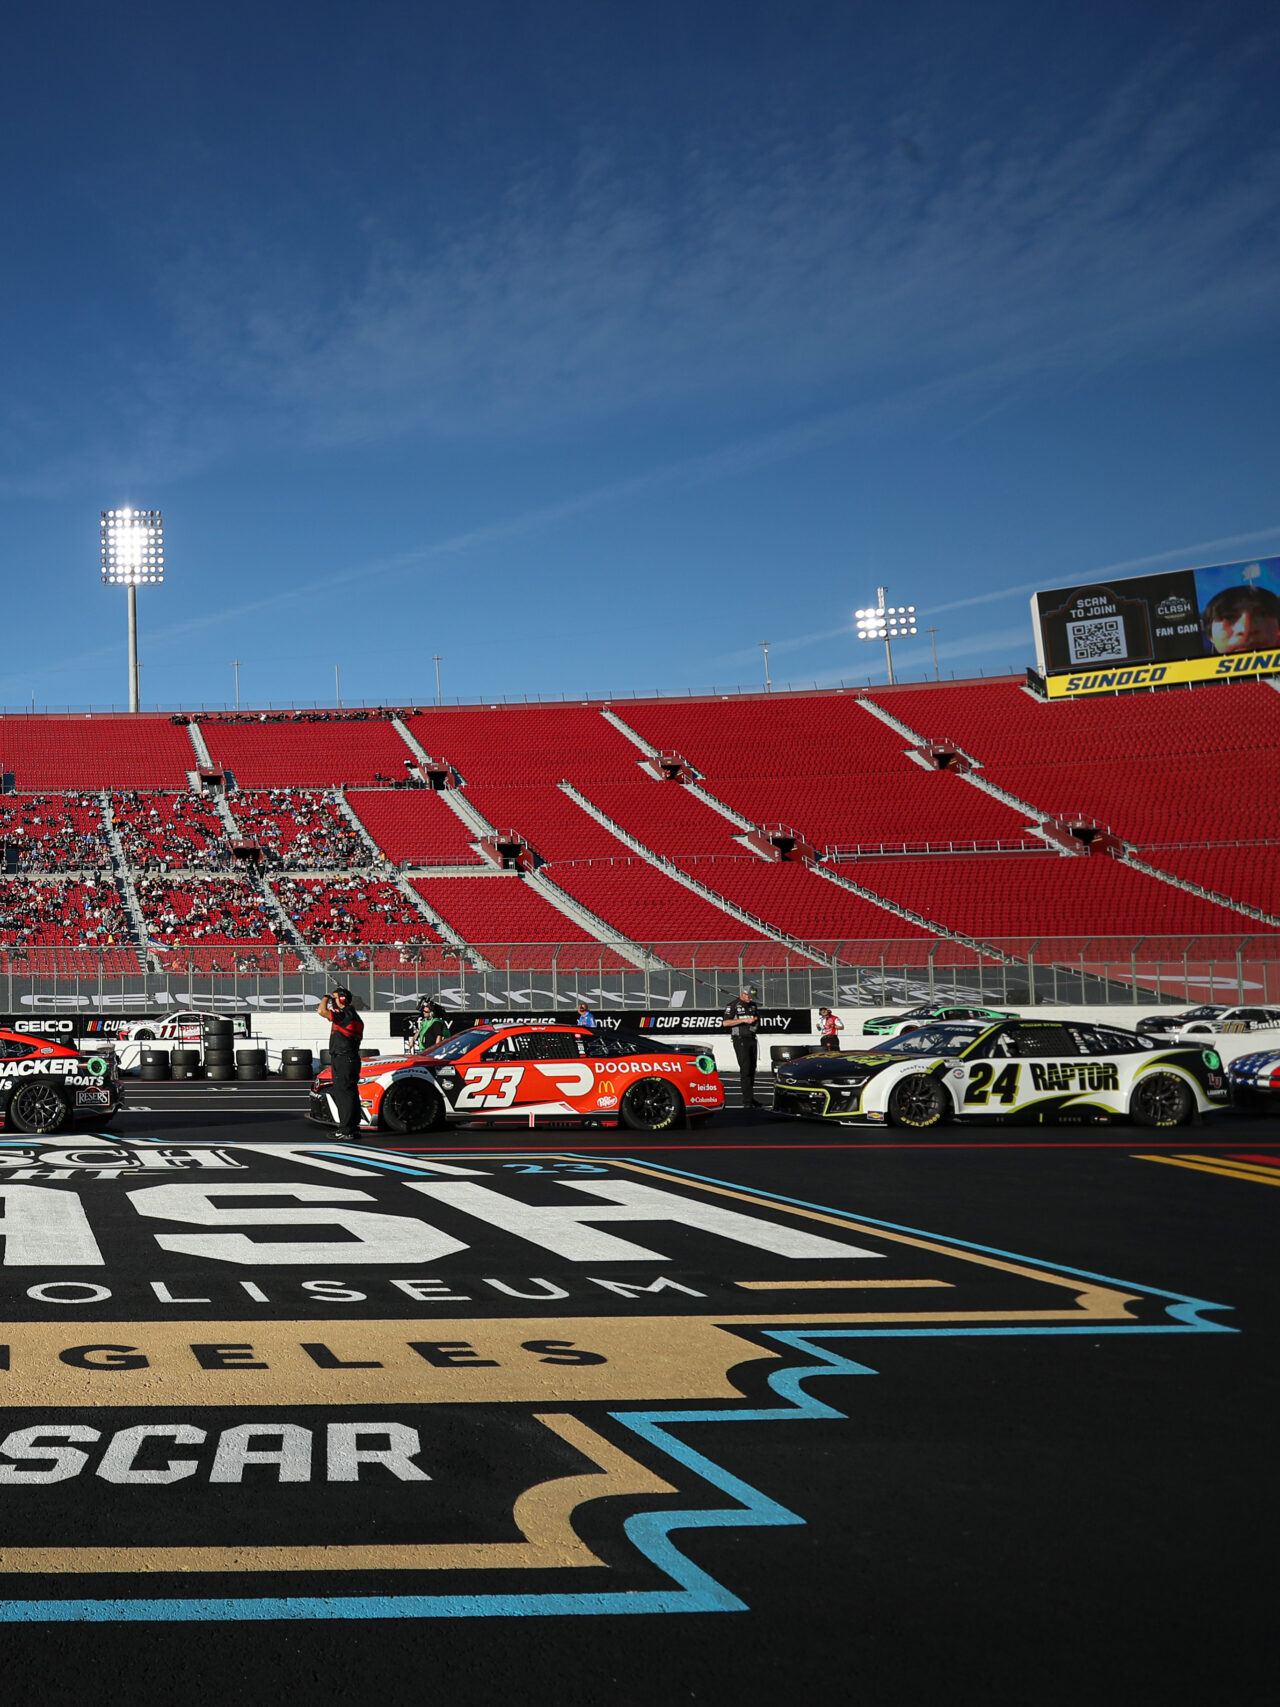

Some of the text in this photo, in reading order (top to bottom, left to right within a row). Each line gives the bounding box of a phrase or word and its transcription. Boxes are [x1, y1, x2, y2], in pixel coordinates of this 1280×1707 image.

[1076, 596, 1108, 608] SCAN
[1070, 604, 1116, 618] TO JOIN!
[1157, 603, 1191, 615] CLASH
[1156, 623, 1199, 637] FAN CAM
[1066, 667, 1167, 692] SUNOCO
[20, 991, 322, 1007] GEICO
[376, 988, 687, 1008] xfinity
[15, 1020, 73, 1032] GEICO
[656, 1017, 724, 1028] CUP SERIES
[1221, 1022, 1246, 1034] 10
[160, 1025, 177, 1038] 11
[594, 1062, 682, 1074] DOORDASH
[64, 1076, 104, 1087] BOATS
[1029, 1062, 1120, 1092] RAPTOR
[454, 1066, 525, 1109] 23
[697, 1083, 718, 1091] leidos
[964, 1062, 1021, 1106] 24
[502, 1163, 609, 1173] 23
